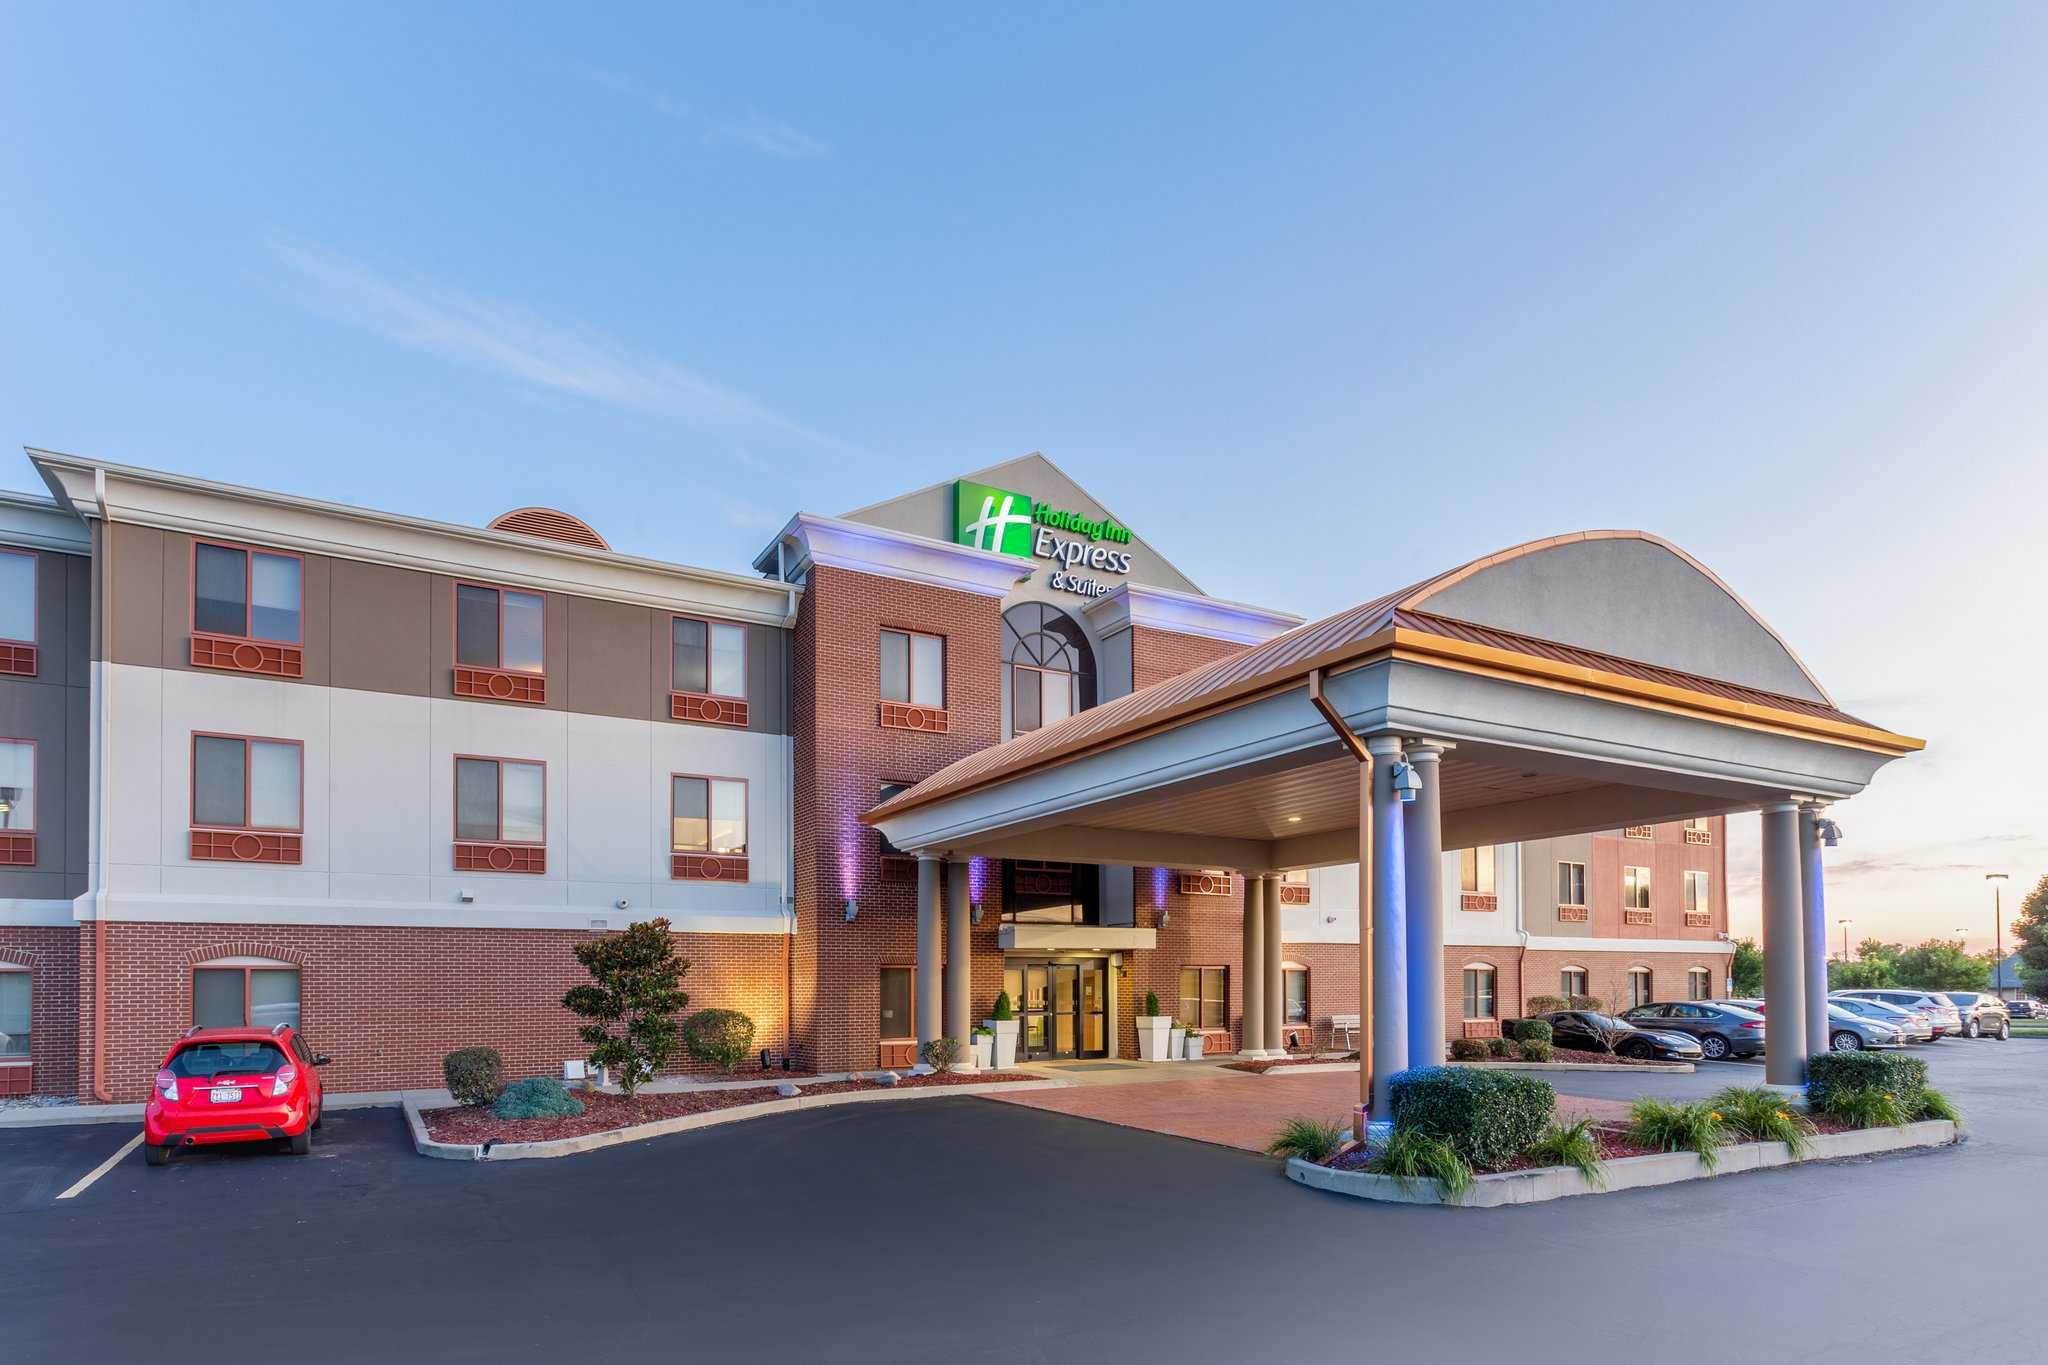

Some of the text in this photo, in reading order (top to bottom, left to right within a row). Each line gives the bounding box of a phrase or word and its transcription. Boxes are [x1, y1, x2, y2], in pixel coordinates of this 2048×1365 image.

[1034, 503, 1132, 544] Holiday Inn
[1034, 527, 1131, 574] Express
[1052, 570, 1064, 589] &
